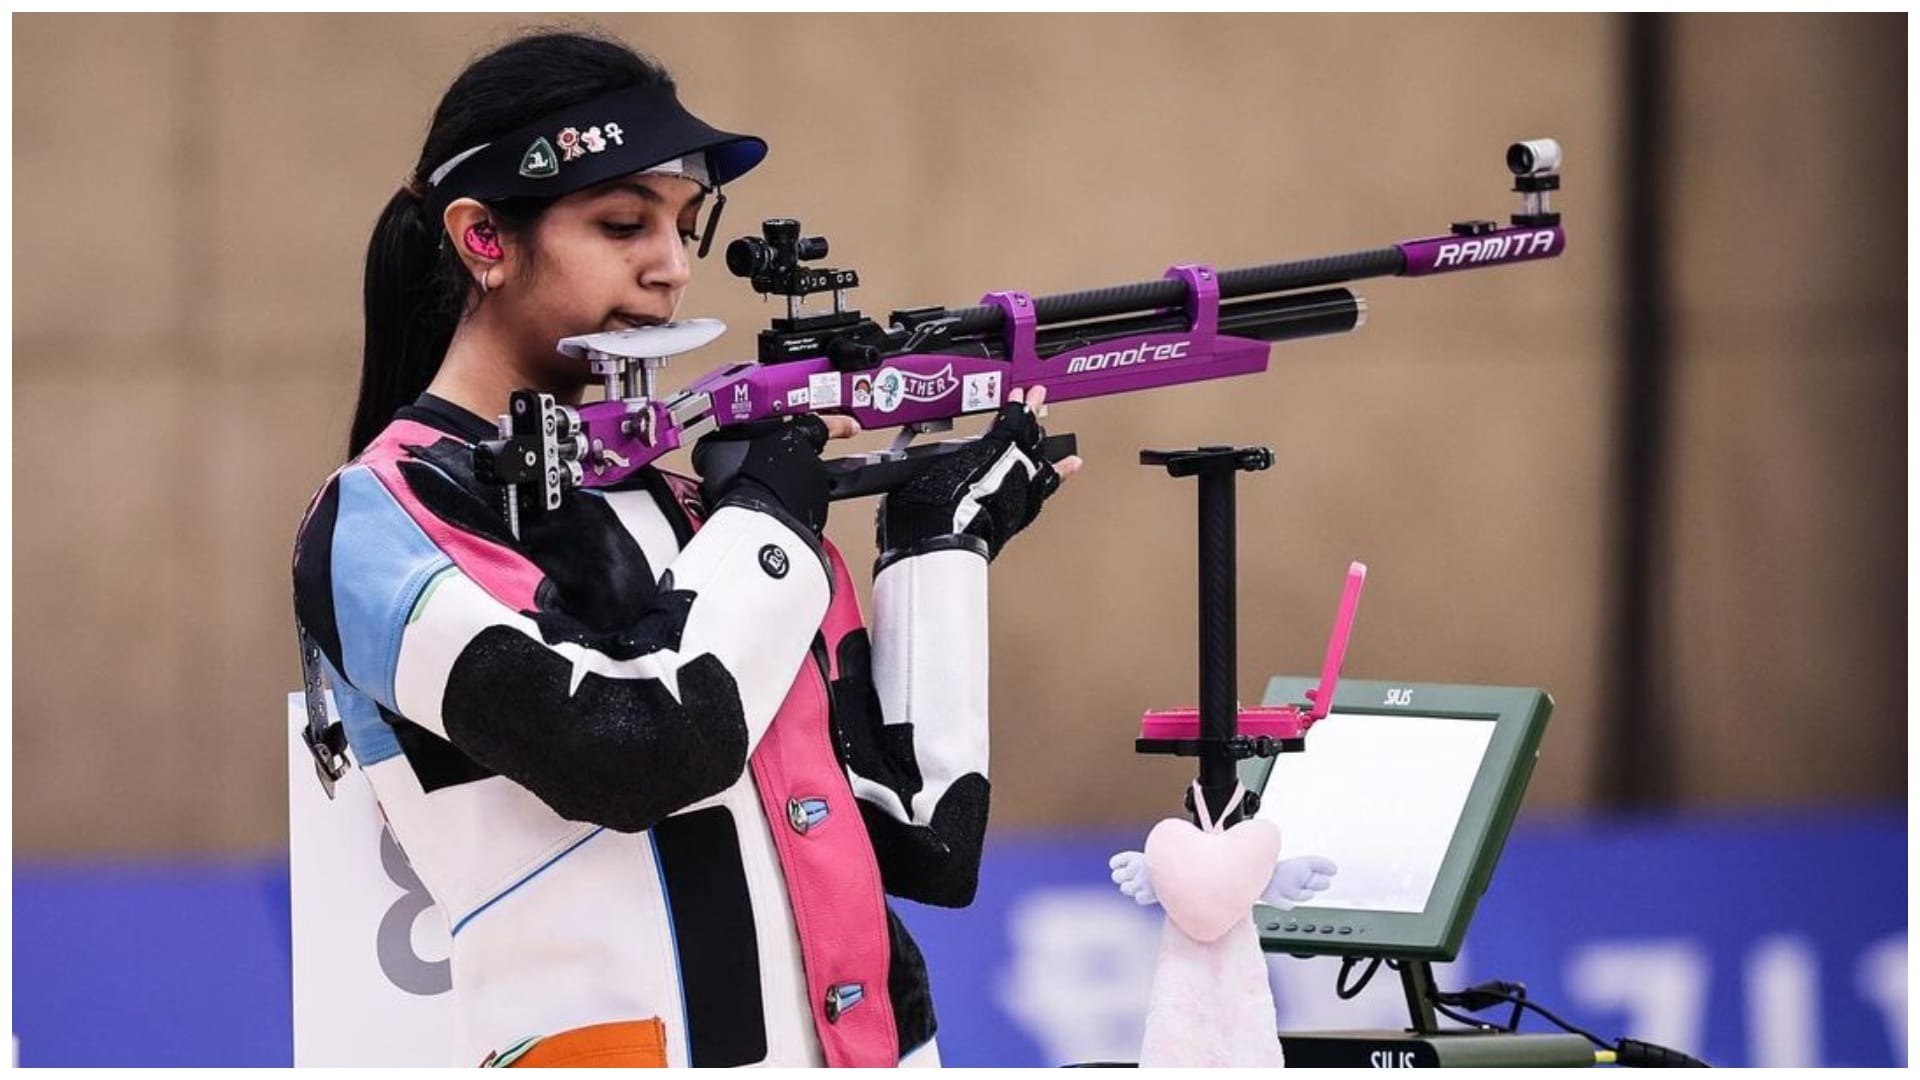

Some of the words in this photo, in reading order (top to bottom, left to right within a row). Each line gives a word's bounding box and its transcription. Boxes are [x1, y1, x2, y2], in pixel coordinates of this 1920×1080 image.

[1433, 230, 1555, 267] RAMITA
[1067, 341, 1190, 373] monotec
[903, 377, 946, 396] LTHER
